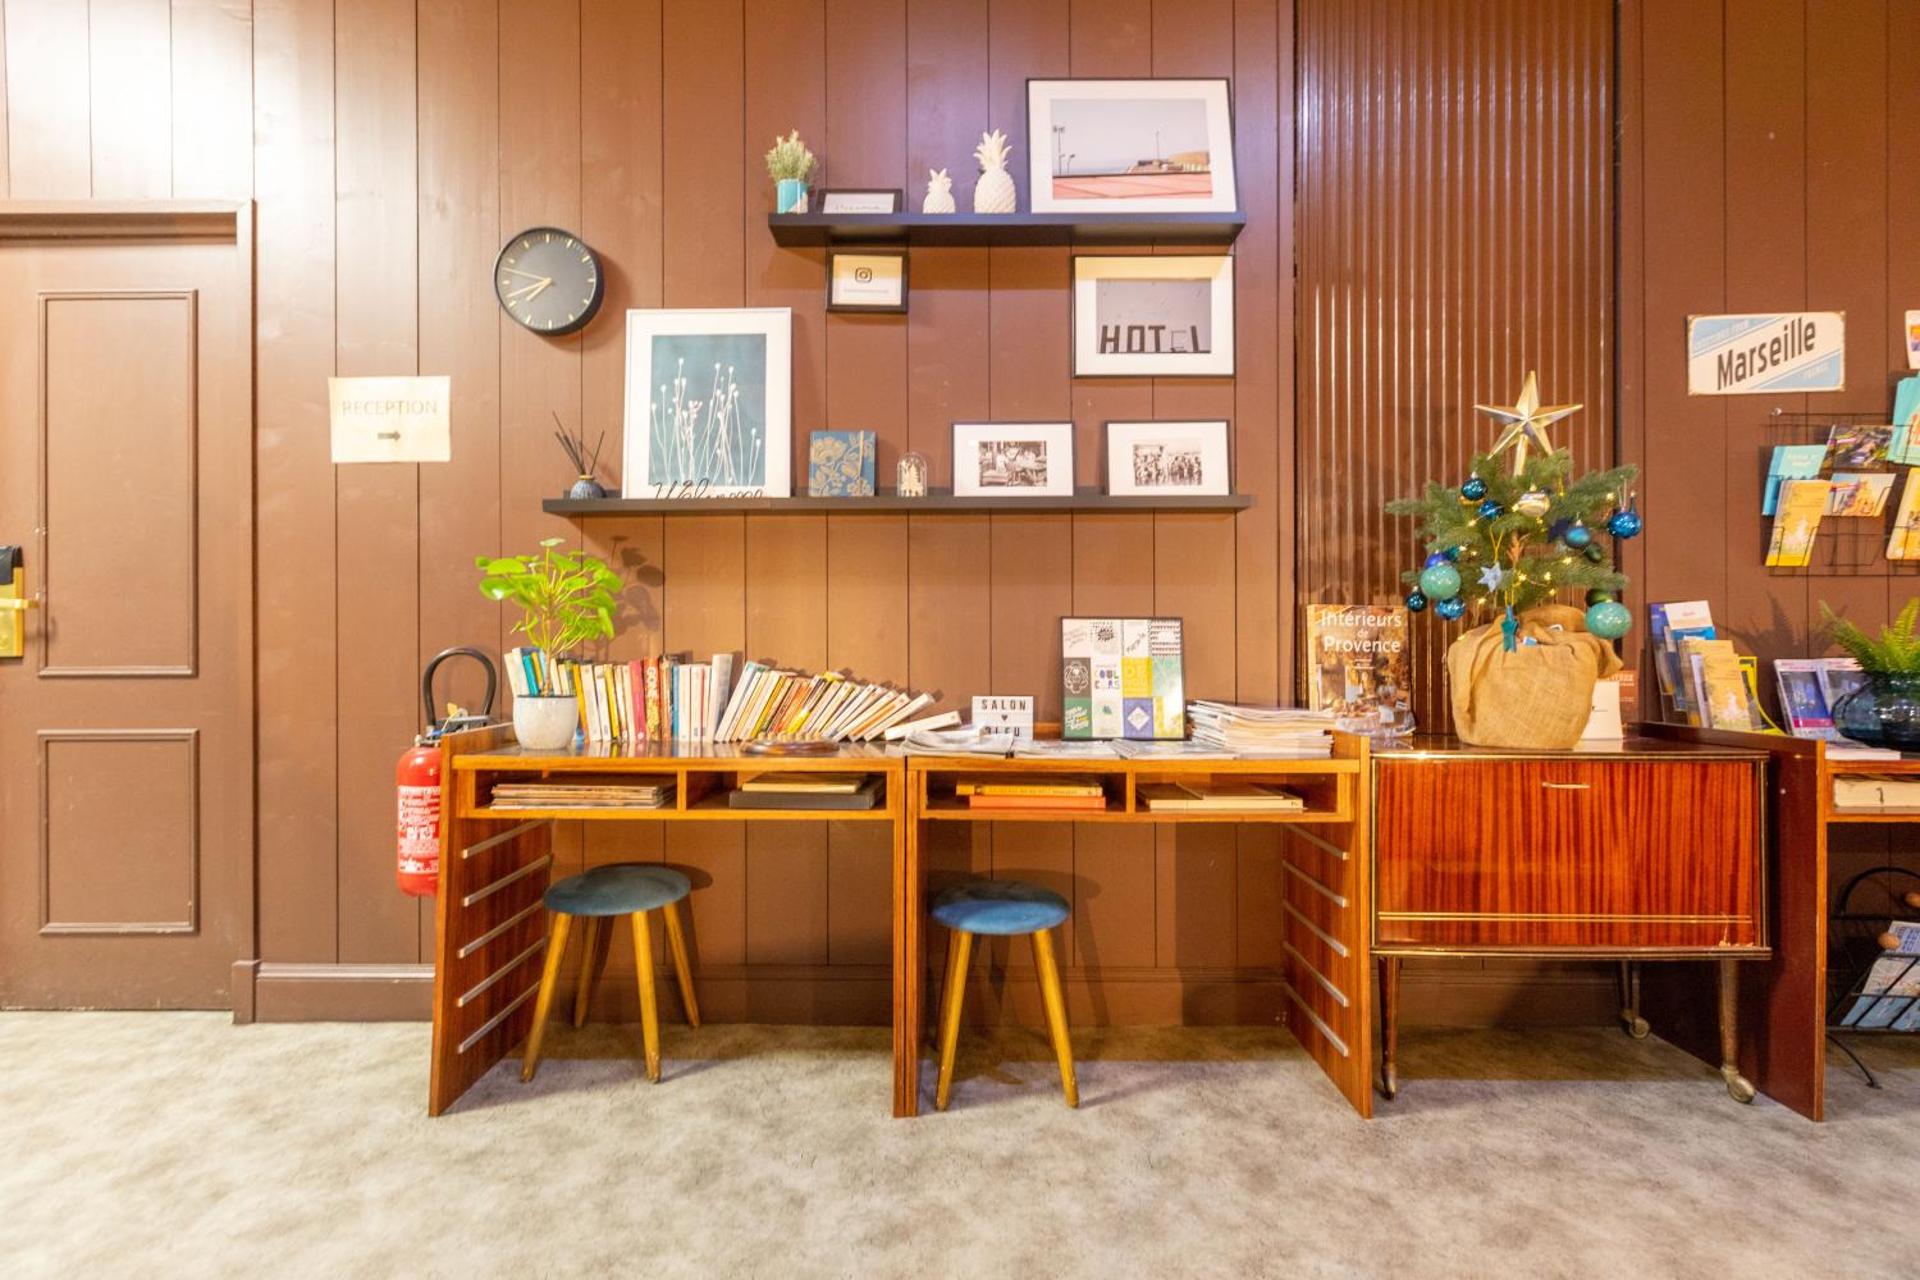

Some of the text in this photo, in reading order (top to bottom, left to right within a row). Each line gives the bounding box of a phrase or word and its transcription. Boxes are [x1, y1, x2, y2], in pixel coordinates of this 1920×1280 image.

[1717, 317, 1815, 391] Marseille
[342, 400, 437, 415] RECEPTION
[1321, 610, 1402, 627] Intérieurs
[1324, 635, 1401, 653] Provence
[981, 699, 1026, 711] SALON
